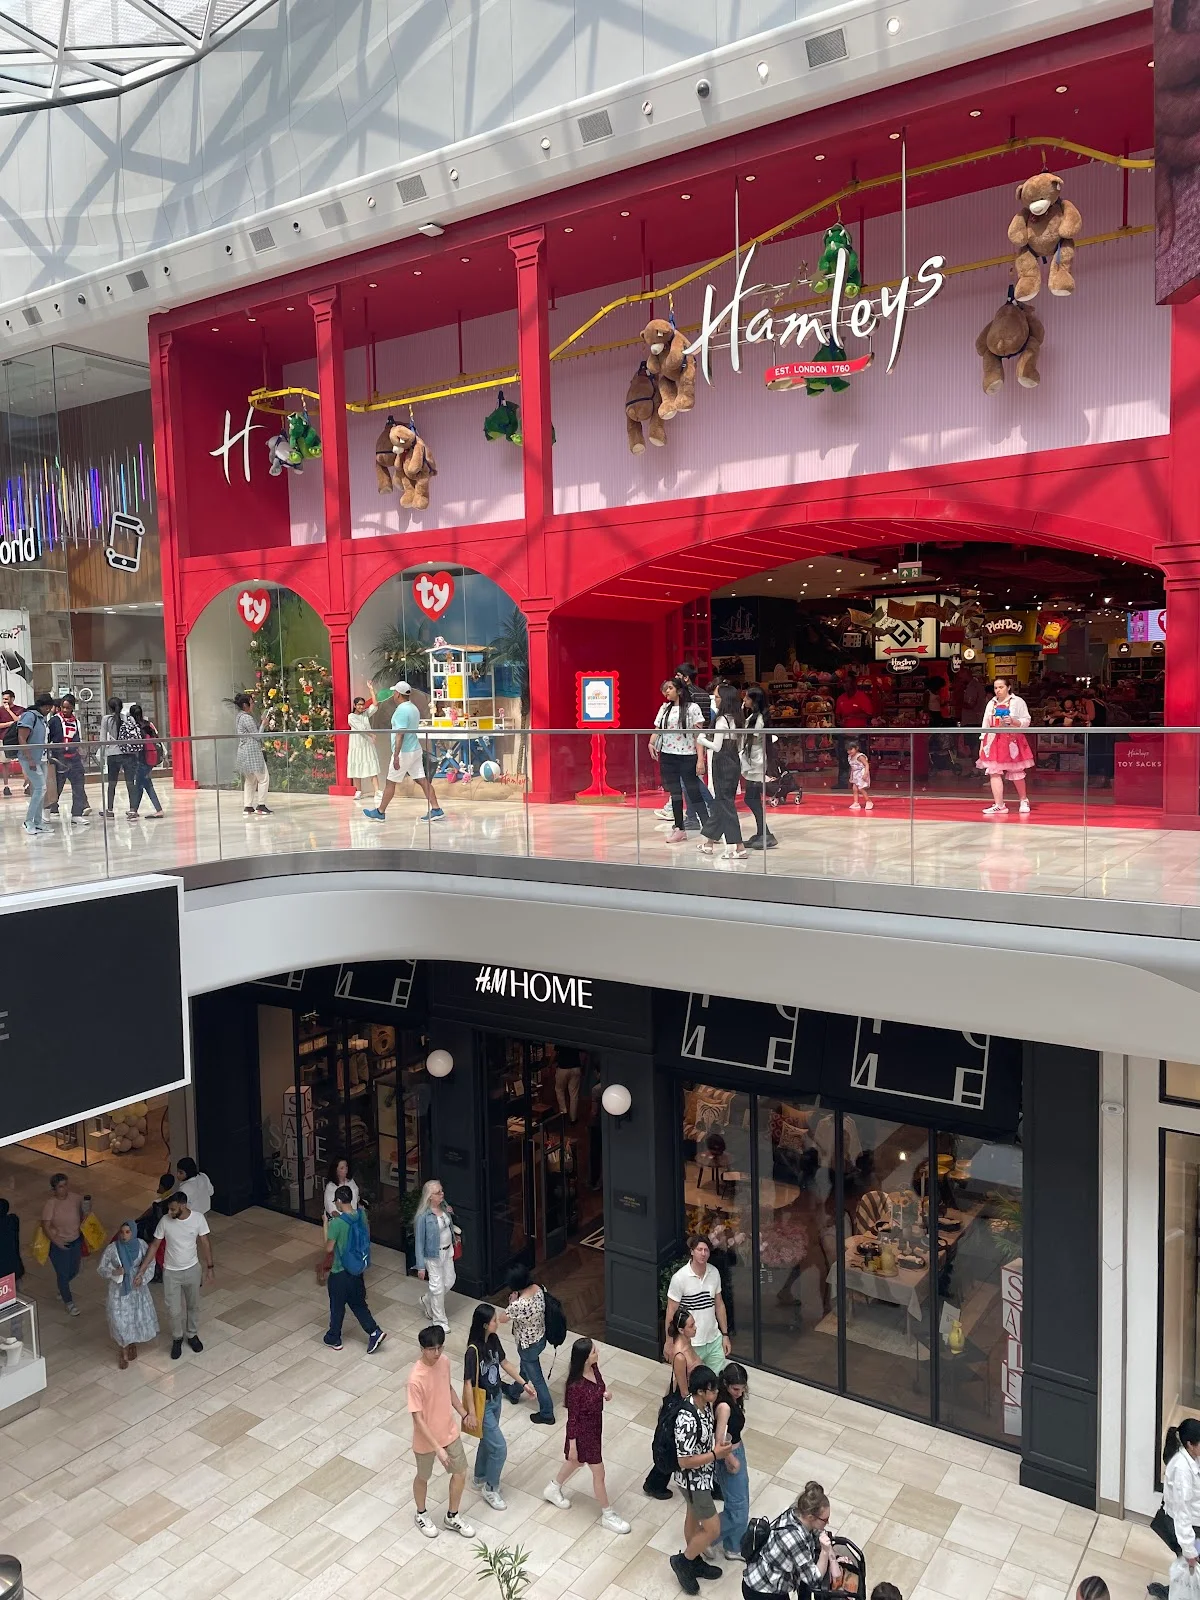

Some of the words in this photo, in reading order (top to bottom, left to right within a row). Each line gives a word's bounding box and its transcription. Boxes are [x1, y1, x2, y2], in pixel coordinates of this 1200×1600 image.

[682, 241, 946, 386] Hamleys
[774, 366, 792, 376] EST.
[793, 364, 828, 375] LONDON
[831, 363, 851, 374] 1760
[209, 407, 267, 485] H
[239, 591, 268, 625] ty
[416, 575, 450, 612] ty
[985, 618, 1023, 634] Play-Doh
[891, 657, 917, 667] Hasbro
[475, 965, 508, 996] H&M
[510, 969, 593, 1010] HOME
